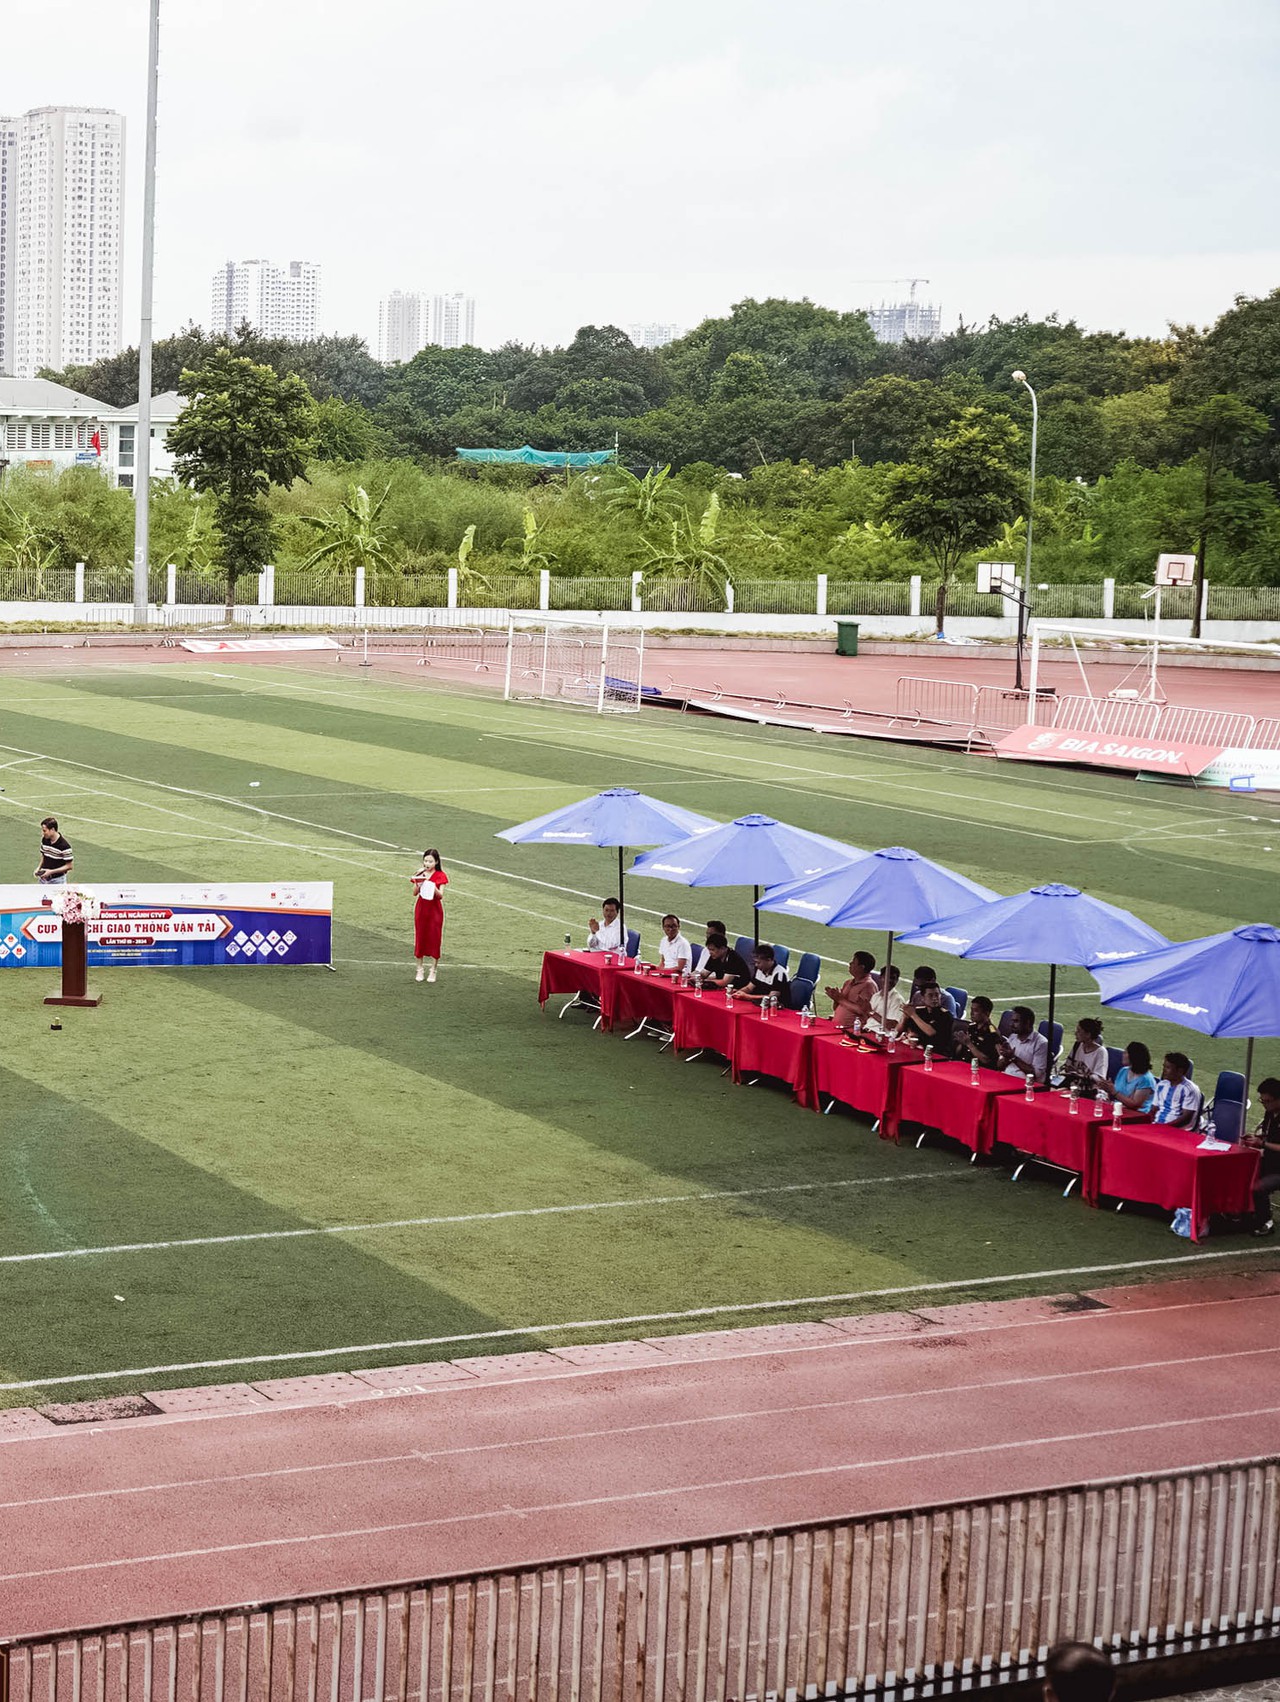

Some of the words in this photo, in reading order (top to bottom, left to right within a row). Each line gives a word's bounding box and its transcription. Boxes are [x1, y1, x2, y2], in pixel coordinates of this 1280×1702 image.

[1057, 737, 1099, 753] BIA
[37, 924, 58, 934] CUP
[107, 923, 131, 933] GIAO
[135, 921, 170, 933] THÔNG
[174, 921, 194, 935] VẬN
[197, 919, 216, 933] TẢI
